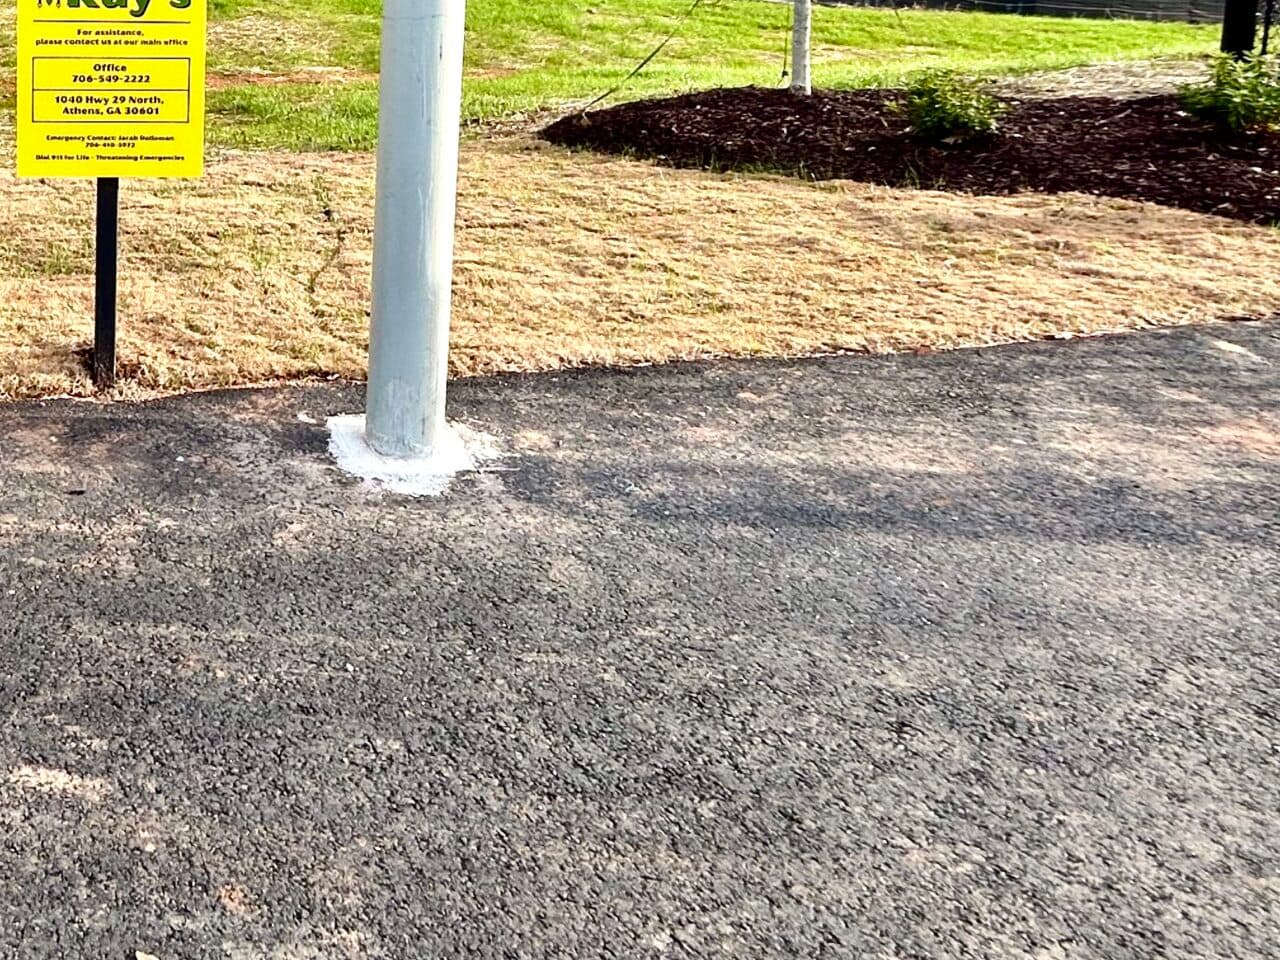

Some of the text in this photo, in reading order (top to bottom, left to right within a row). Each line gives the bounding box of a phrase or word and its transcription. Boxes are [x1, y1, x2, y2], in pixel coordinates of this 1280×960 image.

[95, 29, 144, 37] assistance,
[93, 63, 127, 72] Office
[72, 74, 150, 83] 706-549-2222
[55, 95, 164, 105] 1040 Hwy 29 North,
[62, 106, 159, 115] Athens, GA 30601
